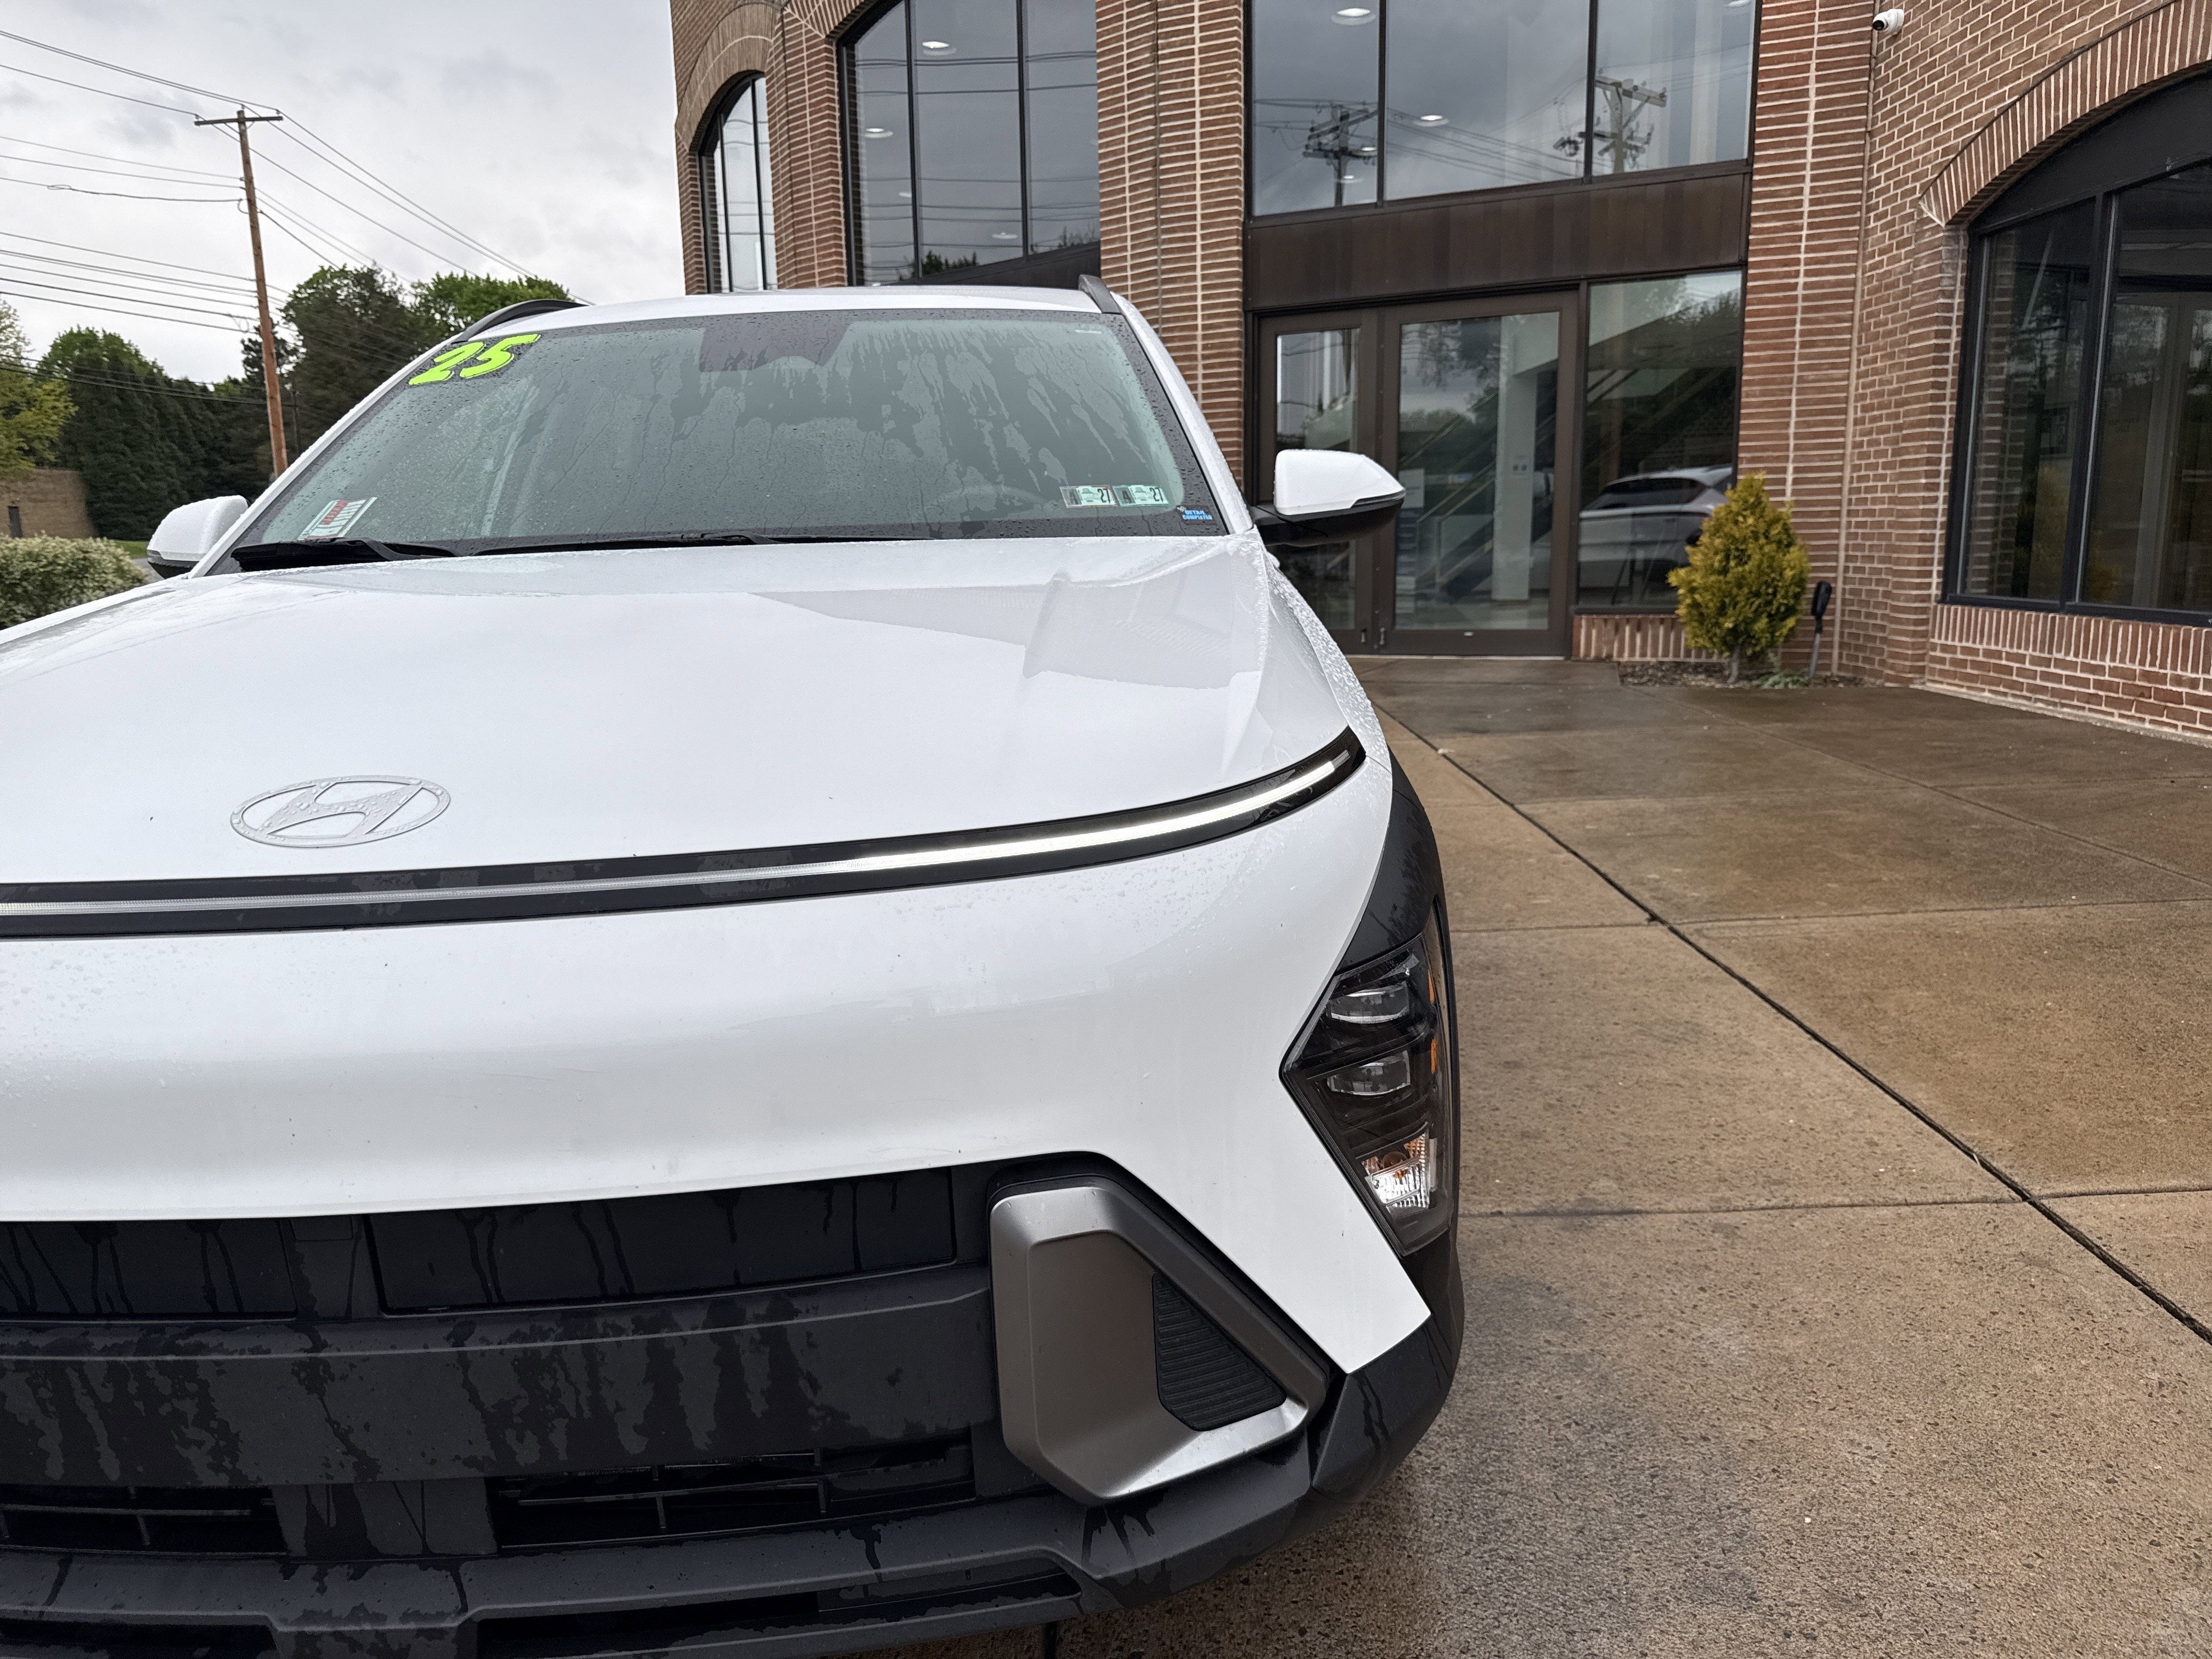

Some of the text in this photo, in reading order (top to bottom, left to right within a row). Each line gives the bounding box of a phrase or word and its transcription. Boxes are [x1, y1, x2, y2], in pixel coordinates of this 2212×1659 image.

[409, 334, 541, 385] 25
[1097, 488, 1111, 504] 27
[1149, 487, 1164, 503] 27
